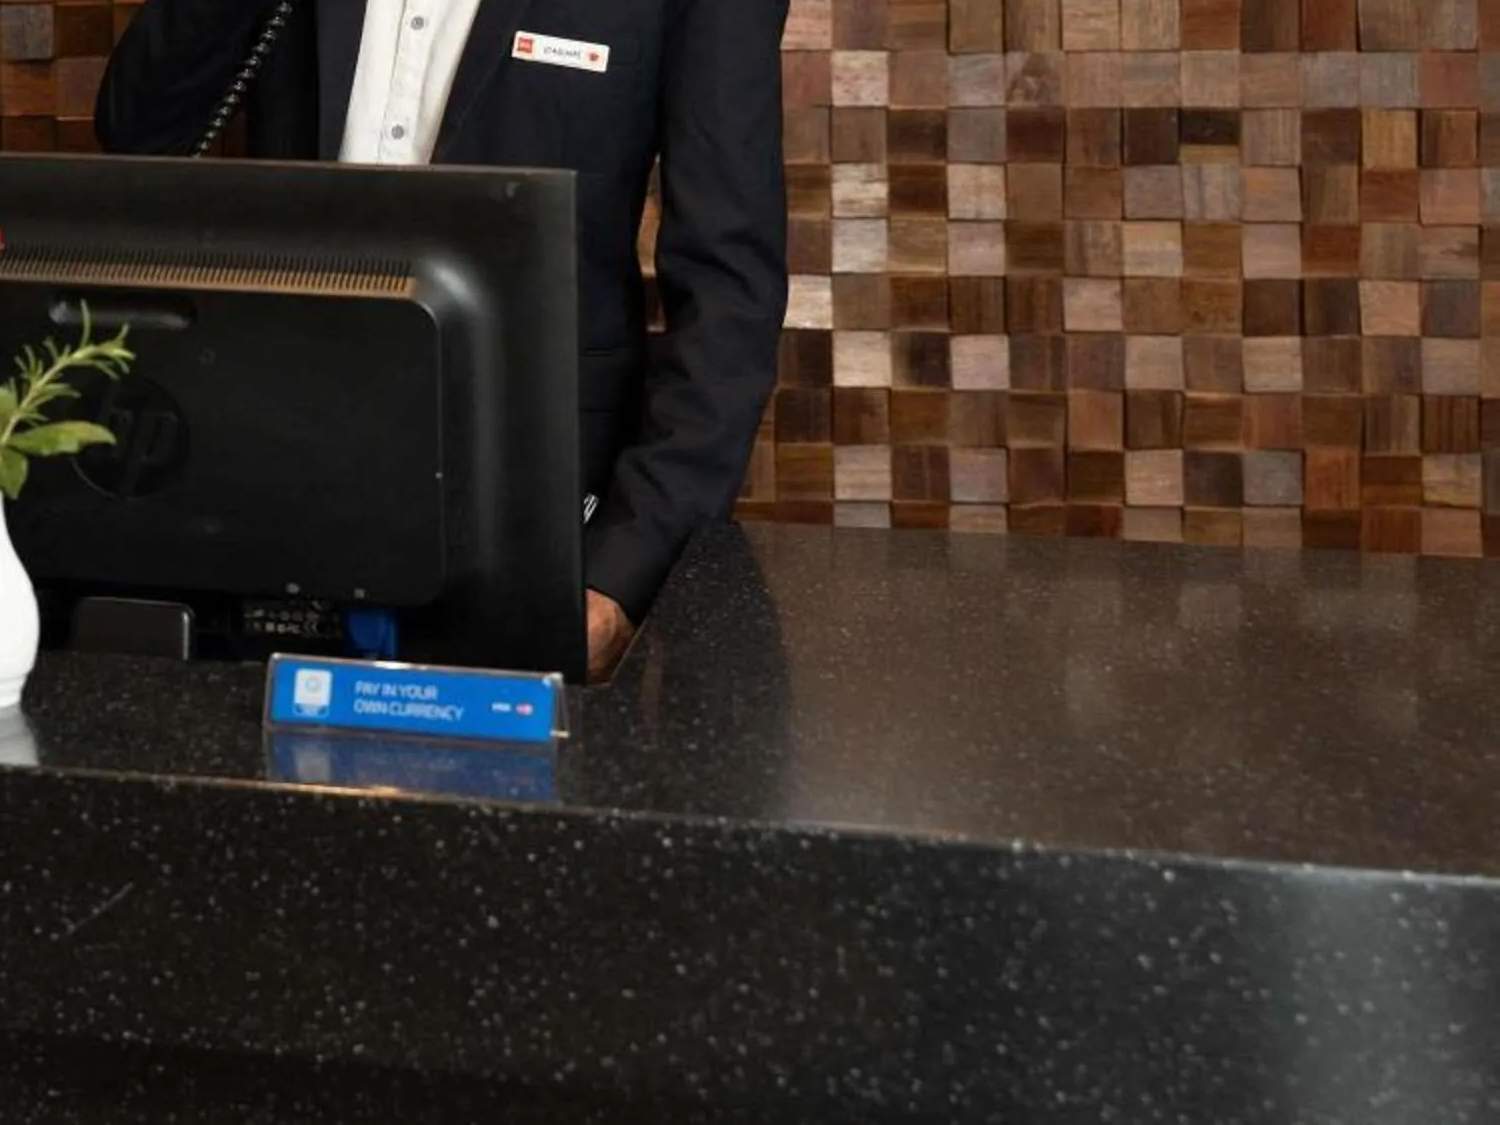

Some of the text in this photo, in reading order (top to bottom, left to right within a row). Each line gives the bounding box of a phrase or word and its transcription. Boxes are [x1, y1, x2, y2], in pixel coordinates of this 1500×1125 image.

[355, 681, 437, 700] PAY IN YOUR
[354, 699, 464, 720] OWN CURRENCY
